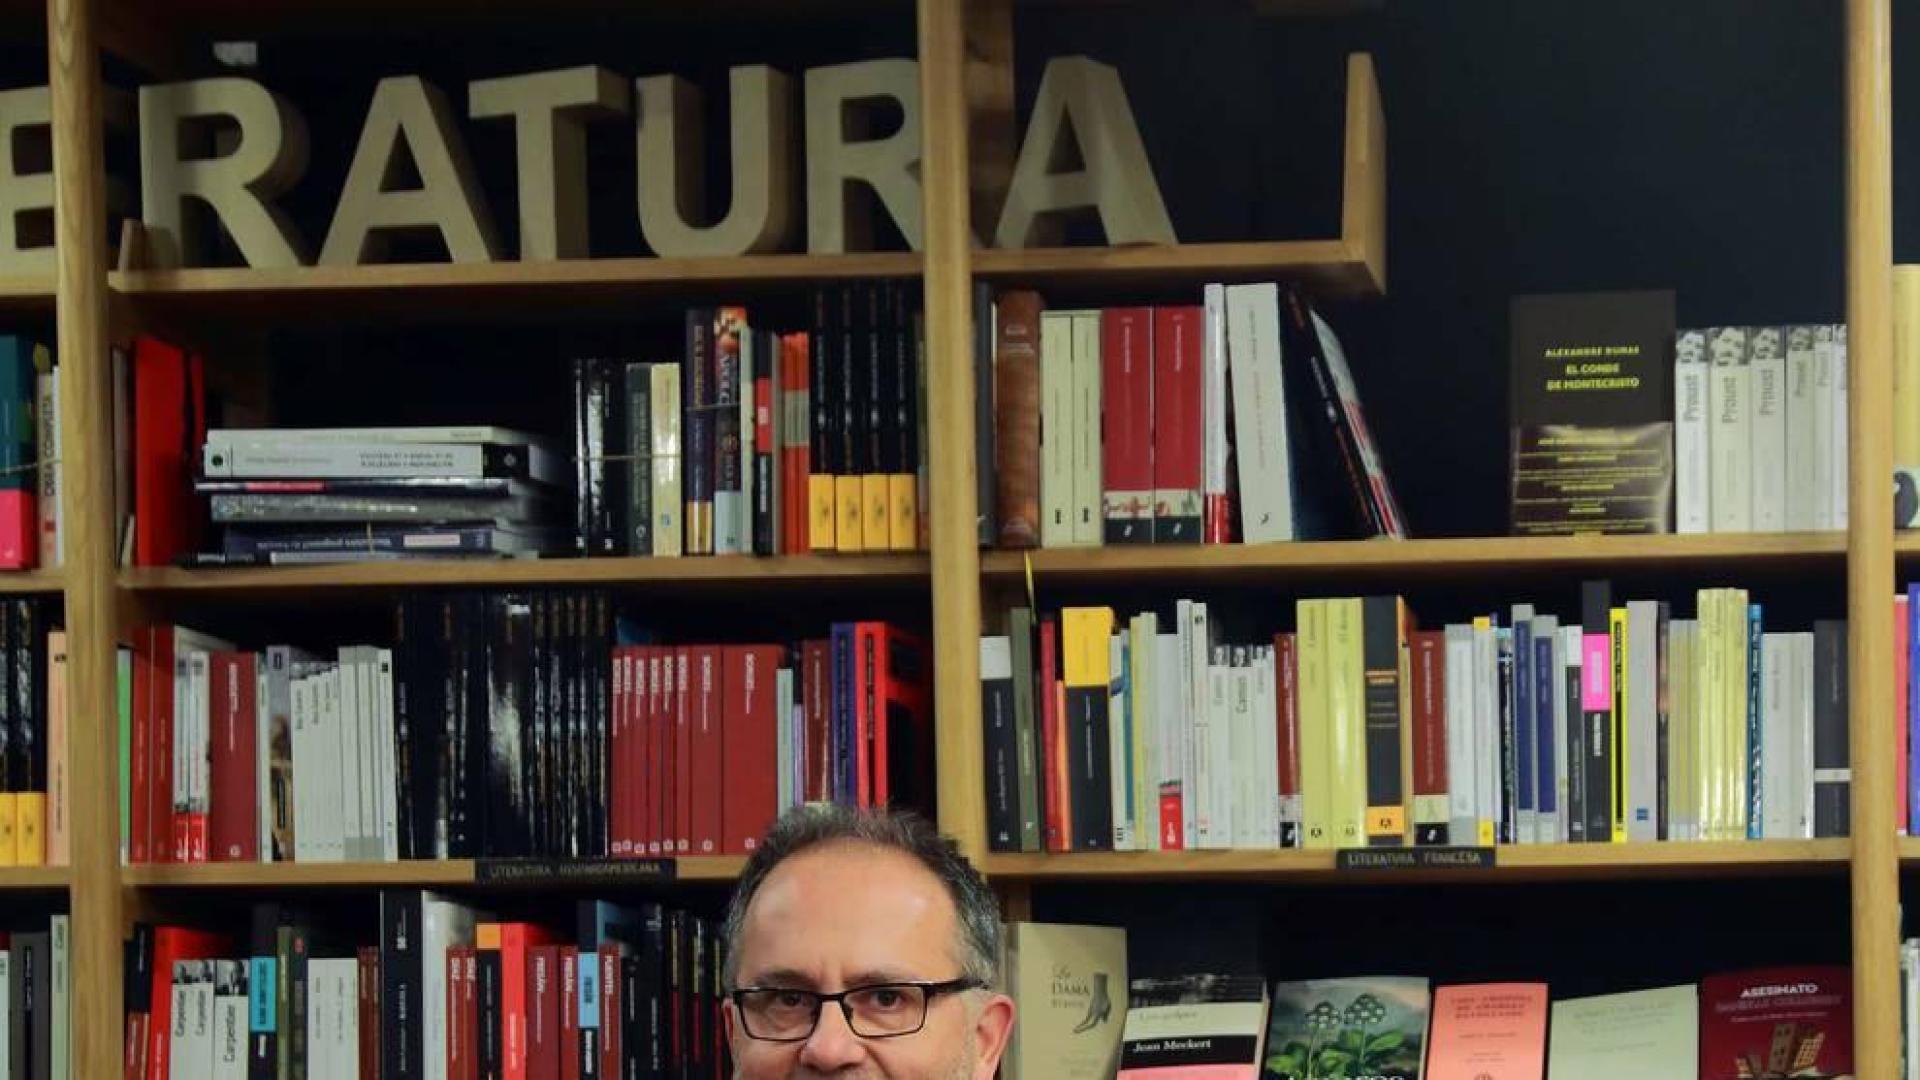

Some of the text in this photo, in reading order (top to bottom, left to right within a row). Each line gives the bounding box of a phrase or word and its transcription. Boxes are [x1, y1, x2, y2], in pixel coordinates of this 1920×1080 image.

[1566, 363, 1620, 375] EL CONDE
[1546, 378, 1640, 391] DE MONTECRISTO
[1759, 369, 1777, 416] Proust
[1683, 375, 1700, 421] Proust
[1721, 377, 1739, 424] Proust
[1347, 850, 1481, 867] LITERATURA FRANCESA
[1740, 982, 1818, 998] ASESINATO
[223, 1004, 237, 1062] Carpentier
[1133, 1038, 1211, 1053] Jean Meckert
